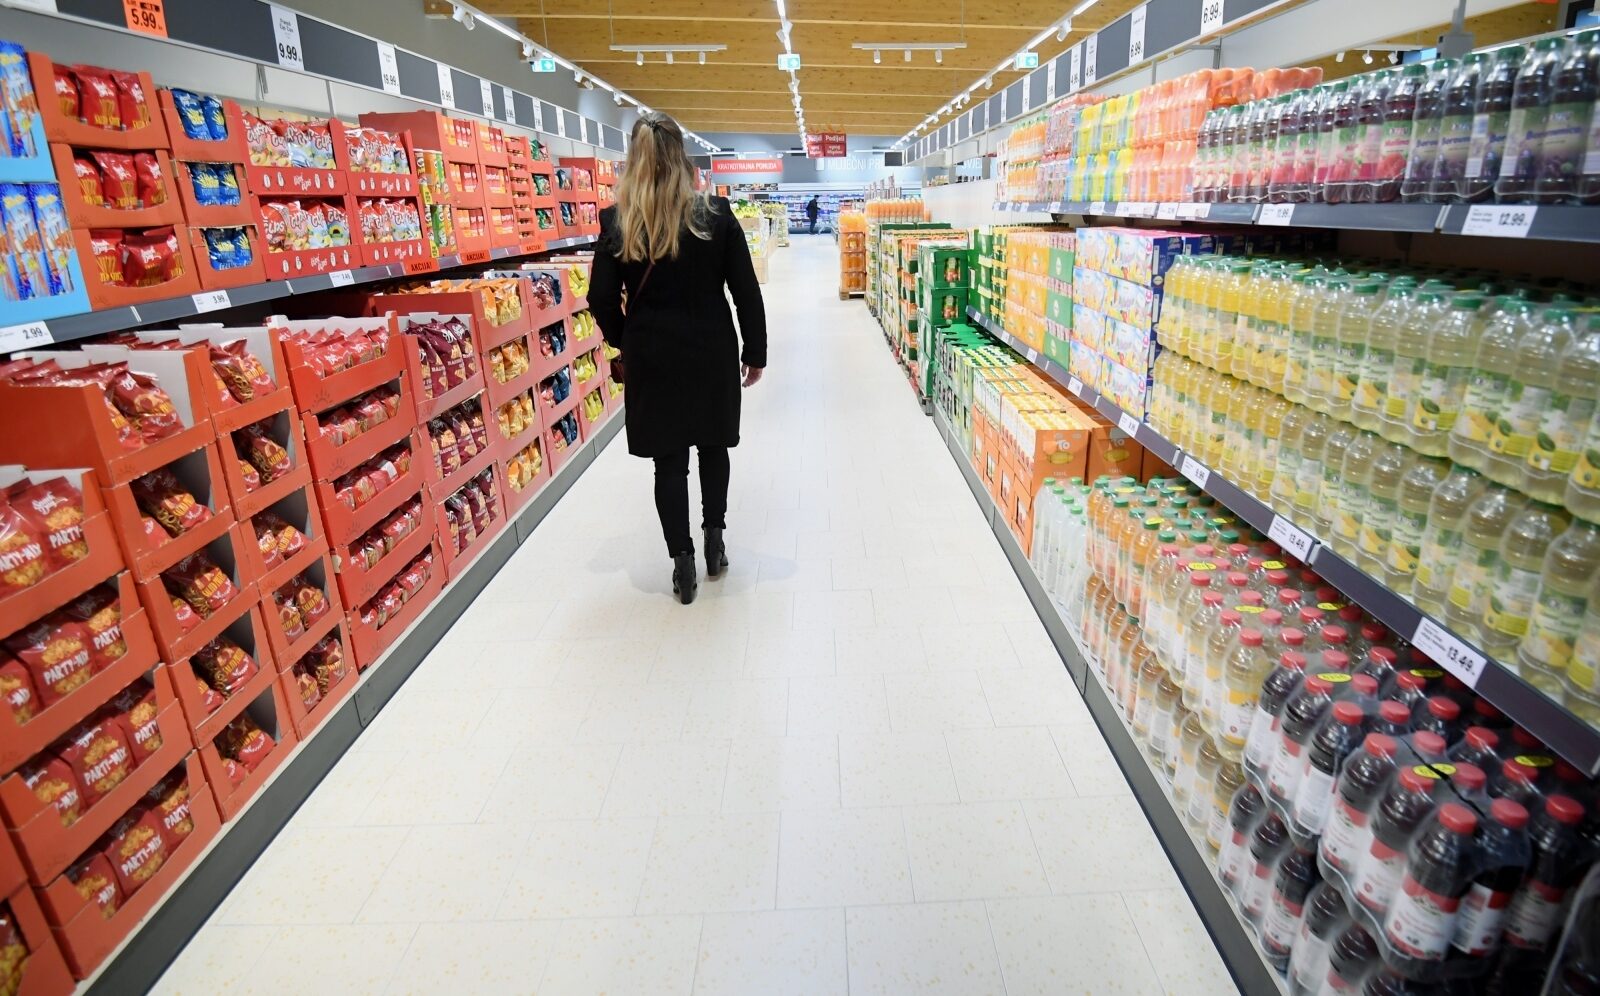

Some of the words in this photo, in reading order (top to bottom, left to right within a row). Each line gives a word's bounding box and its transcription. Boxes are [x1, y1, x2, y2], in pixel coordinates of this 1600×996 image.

[131, 8, 157, 30] 5.99
[1203, 2, 1219, 24] 6.99
[279, 42, 298, 61] 9.99
[717, 162, 755, 170] KRATKOTRAJNA
[23, 327, 43, 341] 2.99
[43, 649, 89, 685] PARTY-MIX
[1446, 645, 1475, 672] 13.49
[84, 747, 127, 785] PARTY-MIX
[121, 835, 162, 876] PARTY-MIX
